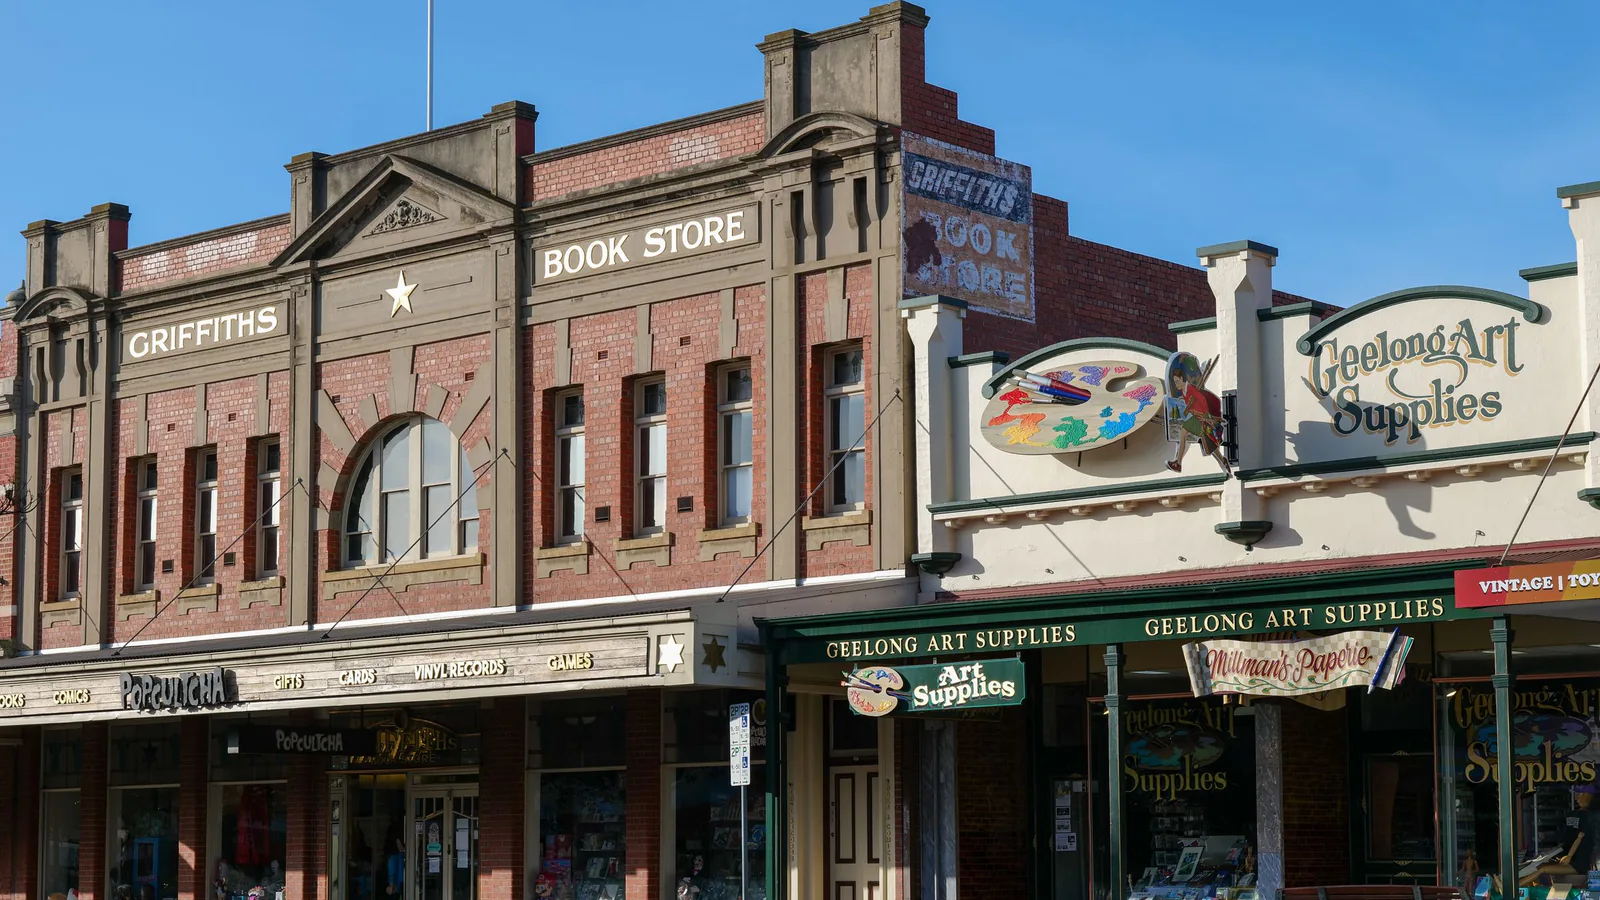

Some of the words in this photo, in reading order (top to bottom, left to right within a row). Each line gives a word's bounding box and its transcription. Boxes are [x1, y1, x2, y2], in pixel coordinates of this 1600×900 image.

[908, 161, 1019, 214] GRIFFITHS
[544, 234, 630, 279] BOOK
[643, 211, 745, 258] STORE
[129, 306, 279, 359] GRIFFITHS
[1309, 324, 1449, 399] Geelong
[1450, 316, 1525, 376] Art
[1333, 378, 1503, 444] Supplies
[1479, 576, 1554, 594] VINTAGE
[1145, 612, 1254, 637] GEELONG
[1265, 608, 1313, 629] ART
[1325, 598, 1445, 624] SUPPLIES
[826, 636, 918, 659] GEELONG
[927, 633, 968, 652] ART
[976, 625, 1077, 649] SUPPLIES
[1205, 649, 1293, 682] Millman's
[1292, 642, 1373, 683] Paperie
[53, 688, 90, 704] COMICS
[273, 673, 304, 689] GIFTS
[338, 668, 377, 685] CARDS
[414, 663, 448, 680] VINYL
[449, 658, 506, 678] RECORDS
[547, 652, 593, 671] GAMES
[912, 677, 1016, 708] Supplies
[938, 662, 984, 687] Art
[1124, 701, 1192, 735] eelong
[1454, 684, 1552, 730] Geeong
[1124, 752, 1229, 801] Supplies
